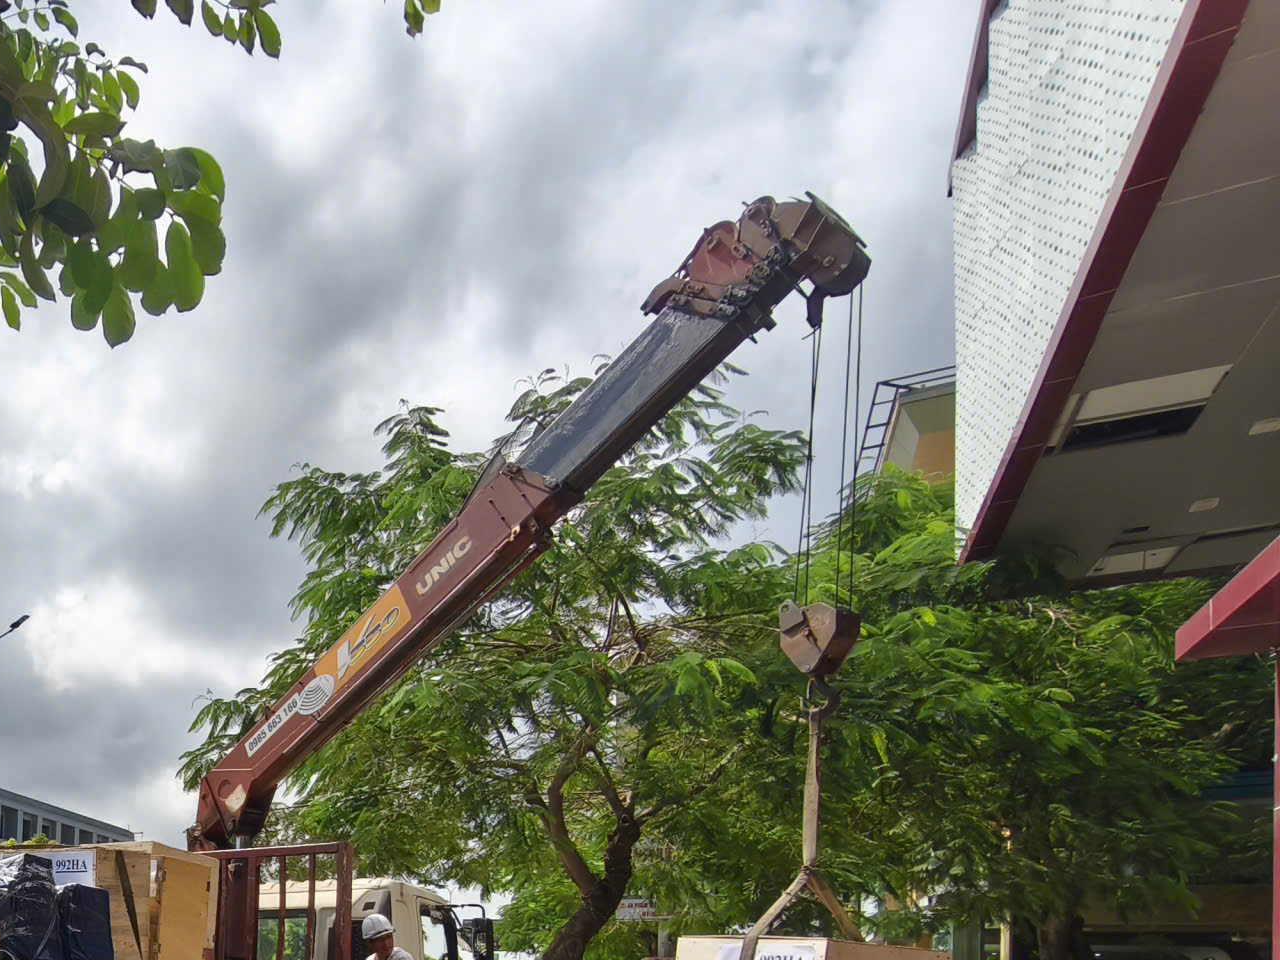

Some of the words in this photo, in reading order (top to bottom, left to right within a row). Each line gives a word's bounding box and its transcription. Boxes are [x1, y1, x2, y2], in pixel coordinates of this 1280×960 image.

[415, 535, 472, 596] UNIC
[248, 729, 267, 751] 0985
[267, 713, 282, 732] 663
[283, 698, 298, 717] 166
[55, 858, 87, 871] 992HA
